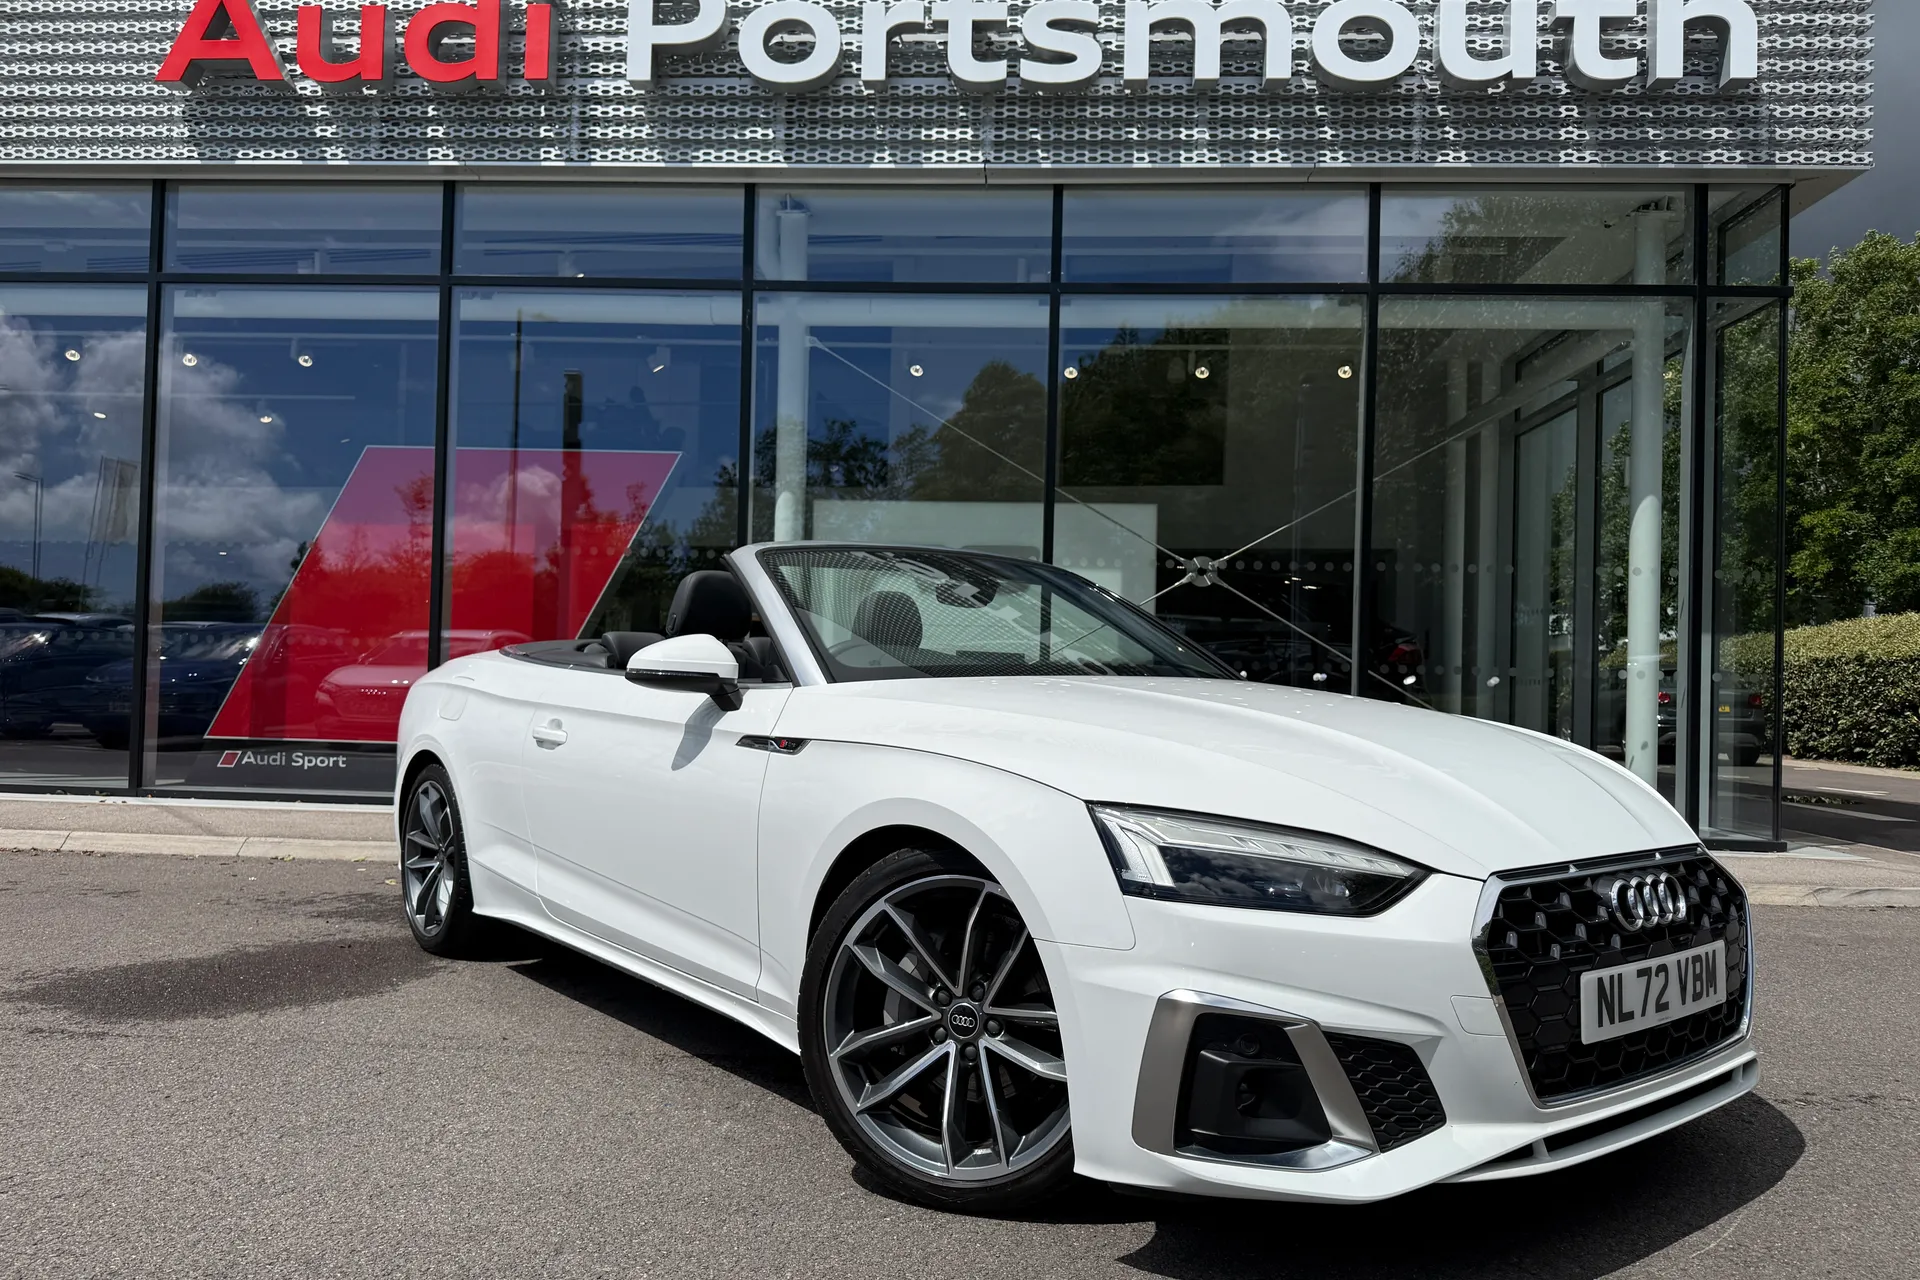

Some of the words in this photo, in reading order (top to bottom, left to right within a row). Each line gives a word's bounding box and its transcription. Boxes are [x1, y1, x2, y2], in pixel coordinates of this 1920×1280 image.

[155, 0, 553, 83] Audi
[626, 0, 1759, 85] Portsmouth
[241, 751, 286, 766] Audi
[291, 752, 347, 770] Sport
[1597, 963, 1670, 1029] NL72
[1676, 949, 1718, 1006] VBM
